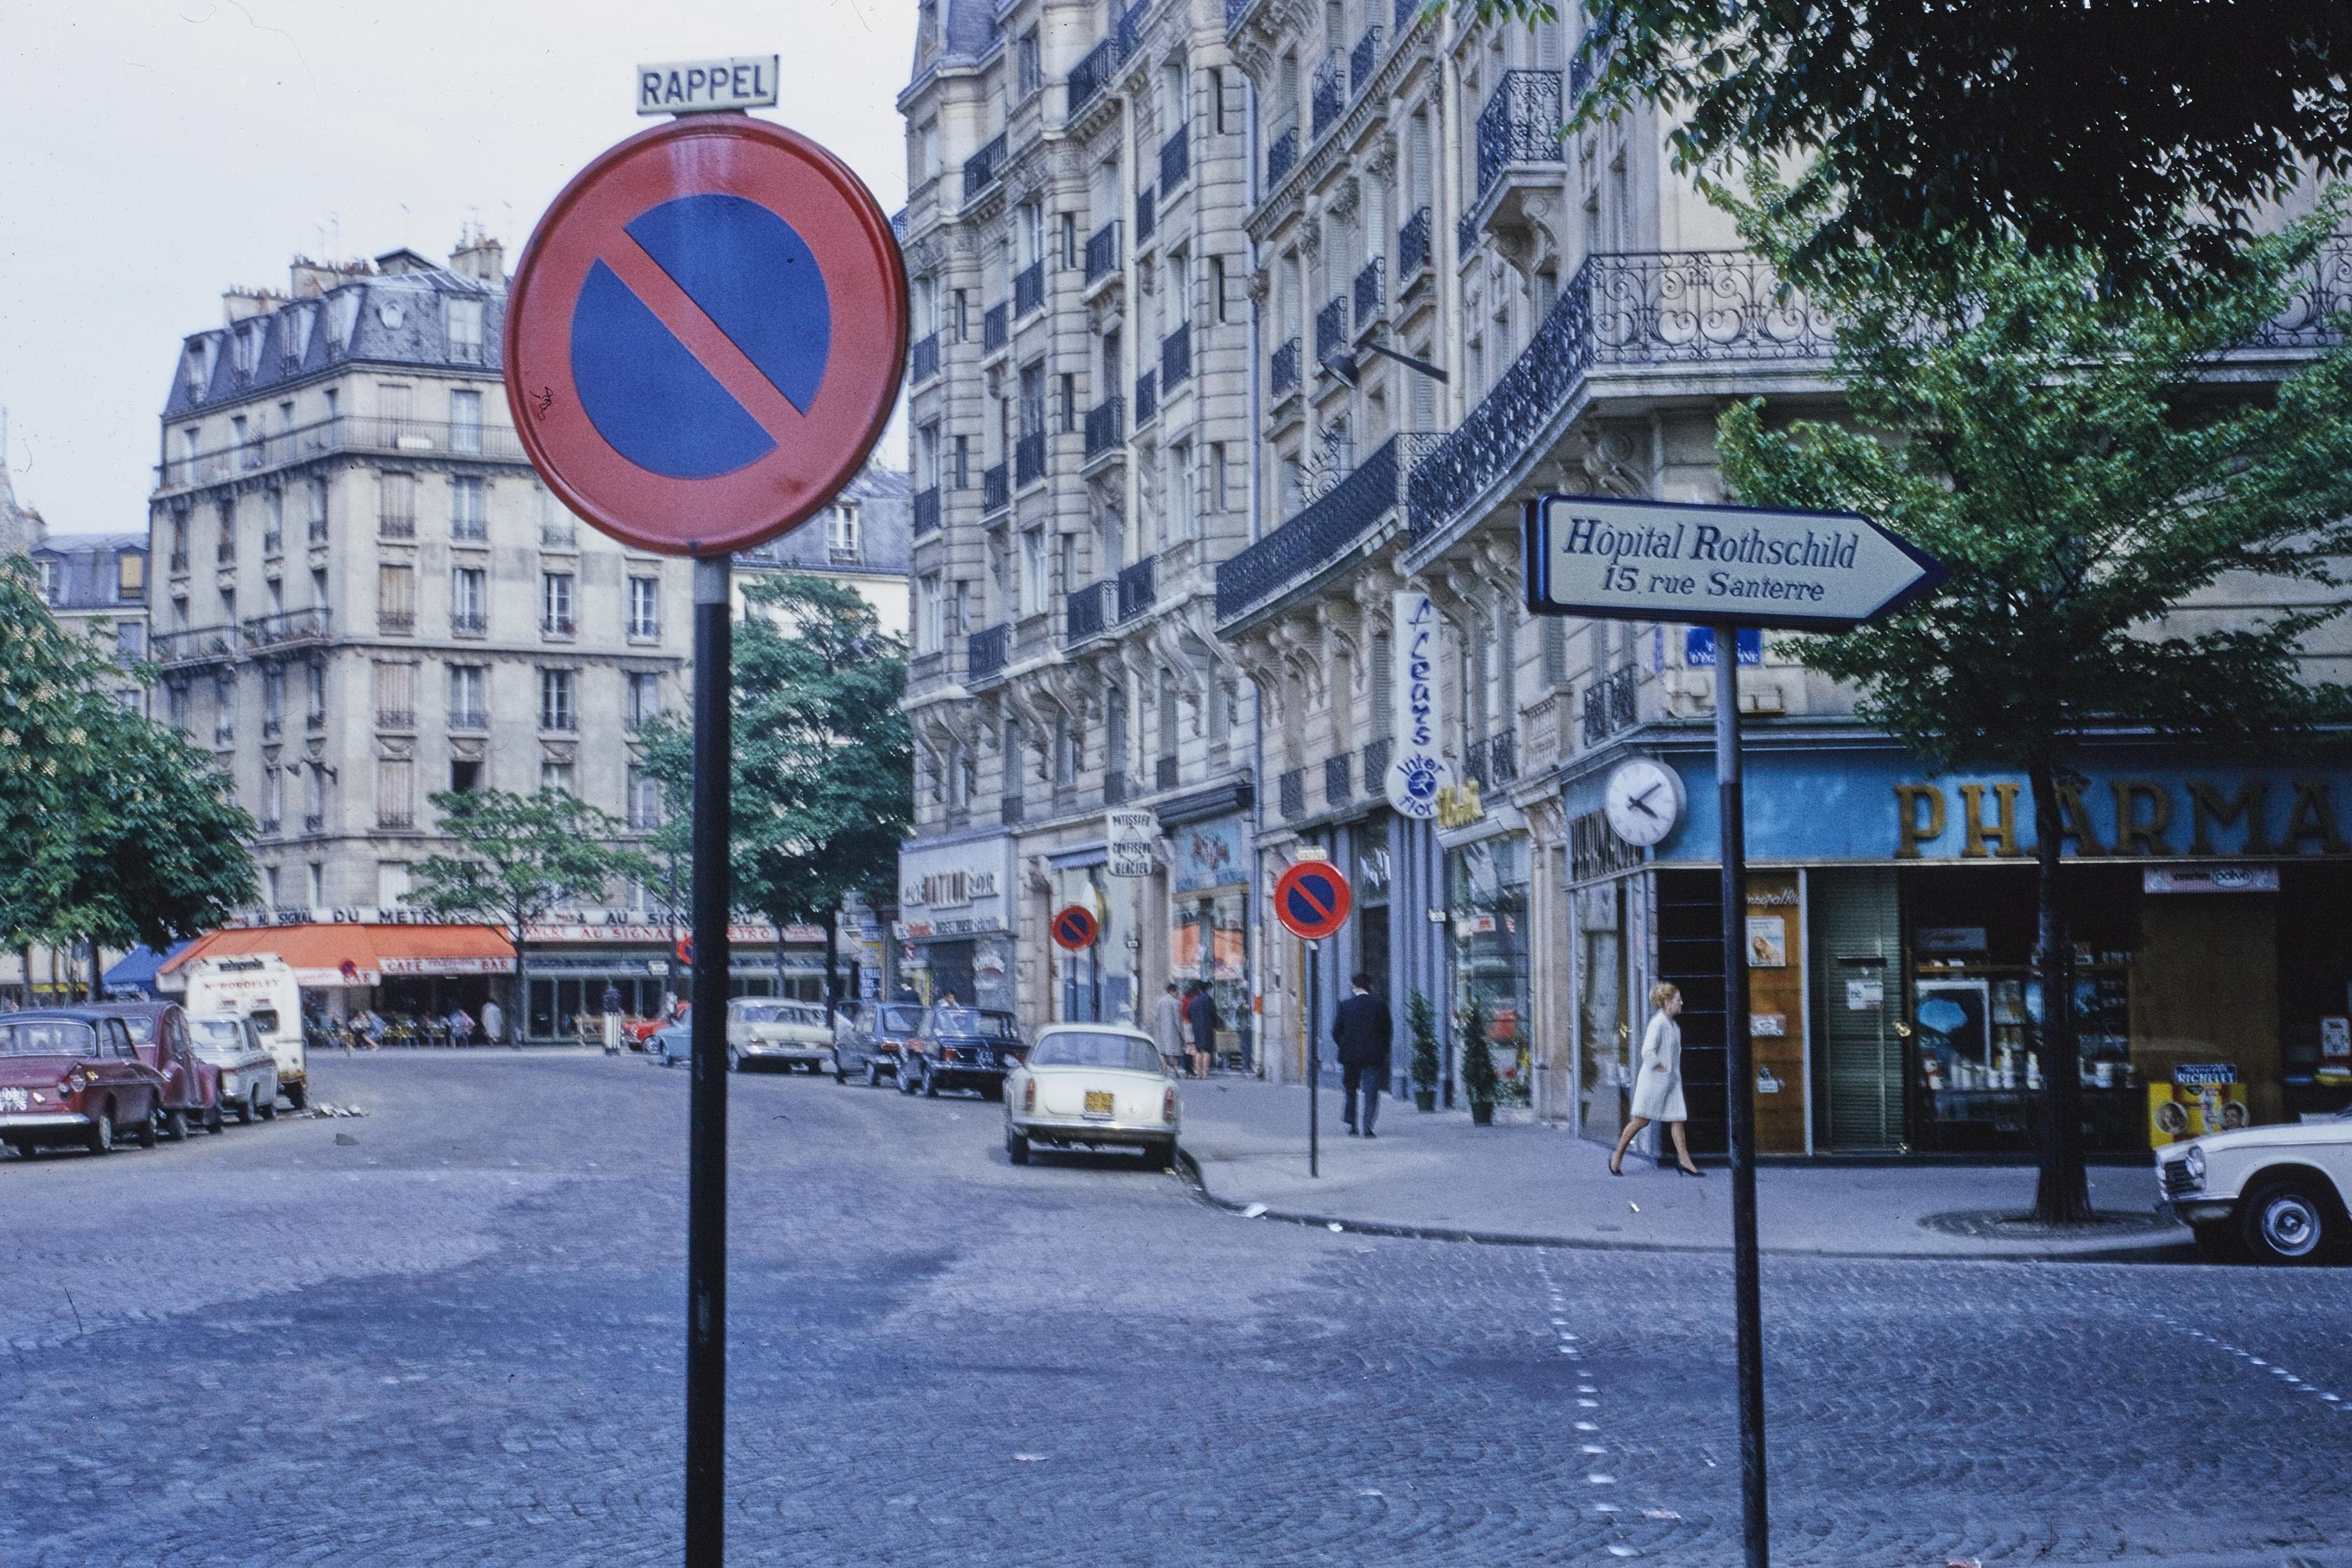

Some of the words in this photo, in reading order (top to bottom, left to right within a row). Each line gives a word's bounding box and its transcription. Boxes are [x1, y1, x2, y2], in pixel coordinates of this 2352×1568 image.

[642, 65, 767, 106] RAPPEL
[1689, 525, 1859, 568] Rothschild
[1648, 575, 1695, 595] rue
[1707, 572, 1824, 601] Santerre
[1894, 780, 2352, 858] PHARMA
[1116, 862, 1148, 873] GLACIER
[278, 911, 317, 925] SIGNAL
[334, 909, 359, 923] DU
[606, 912, 628, 924] AU
[582, 927, 603, 938] AU
[482, 958, 509, 971] BAR
